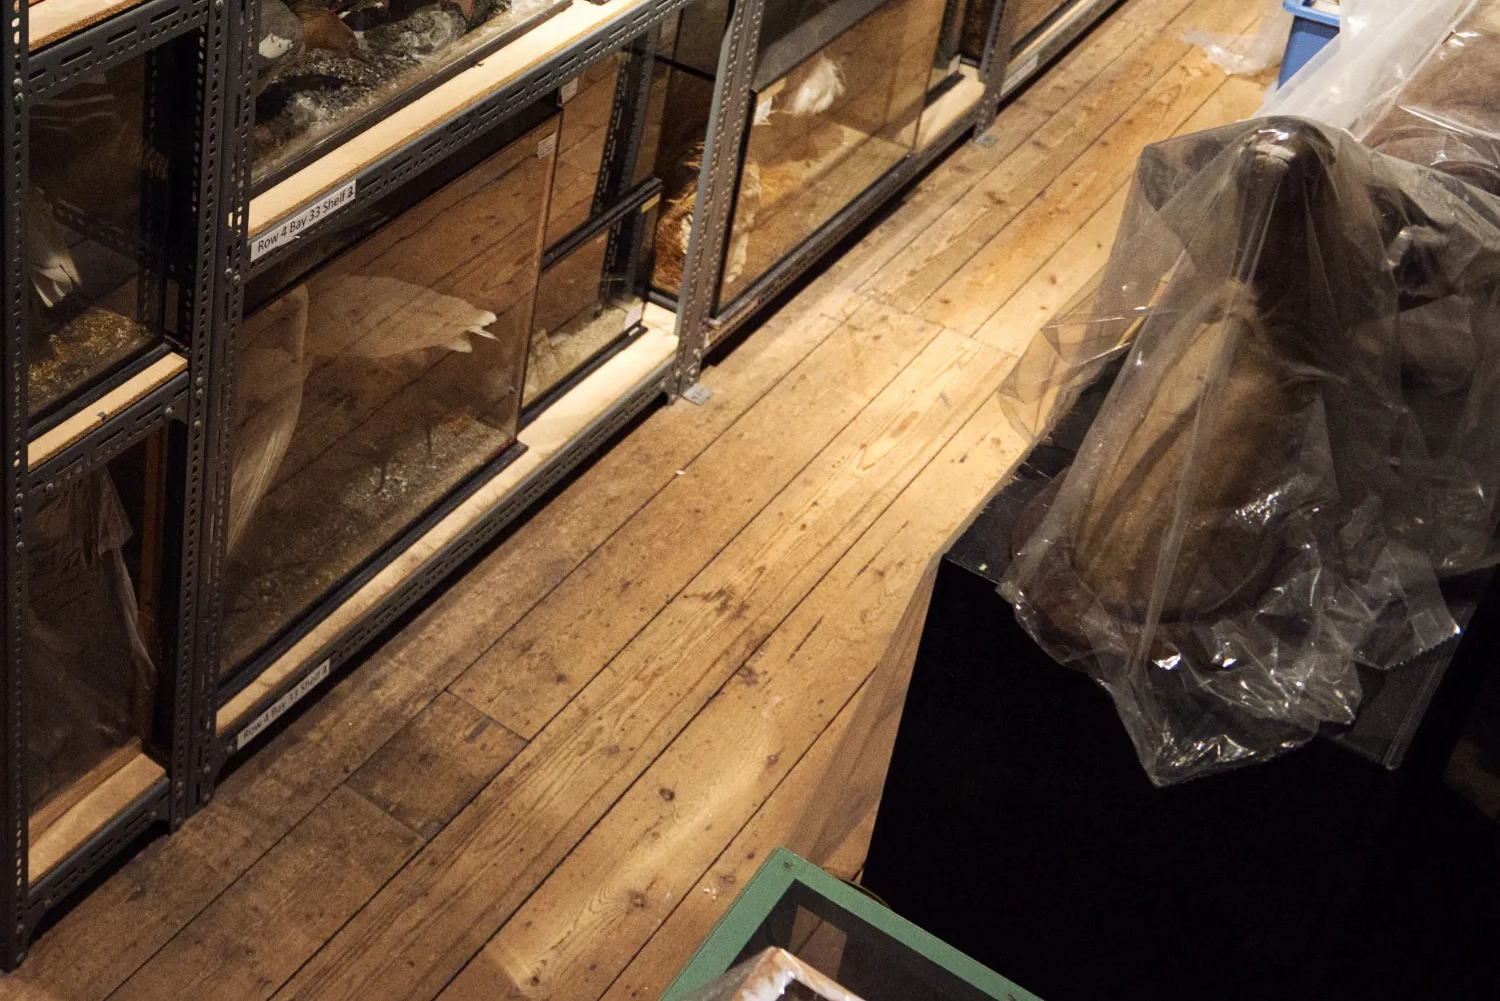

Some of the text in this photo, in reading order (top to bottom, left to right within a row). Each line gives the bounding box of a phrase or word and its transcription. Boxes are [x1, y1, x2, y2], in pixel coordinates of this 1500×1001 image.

[257, 234, 279, 253] Row
[280, 226, 287, 237] 4
[289, 216, 307, 234] Bay
[309, 208, 321, 222] 33
[322, 192, 346, 214] Shelf
[243, 721, 261, 738] Row
[271, 702, 288, 718] Bay
[289, 689, 299, 701] 33
[301, 671, 321, 694] Shelf
